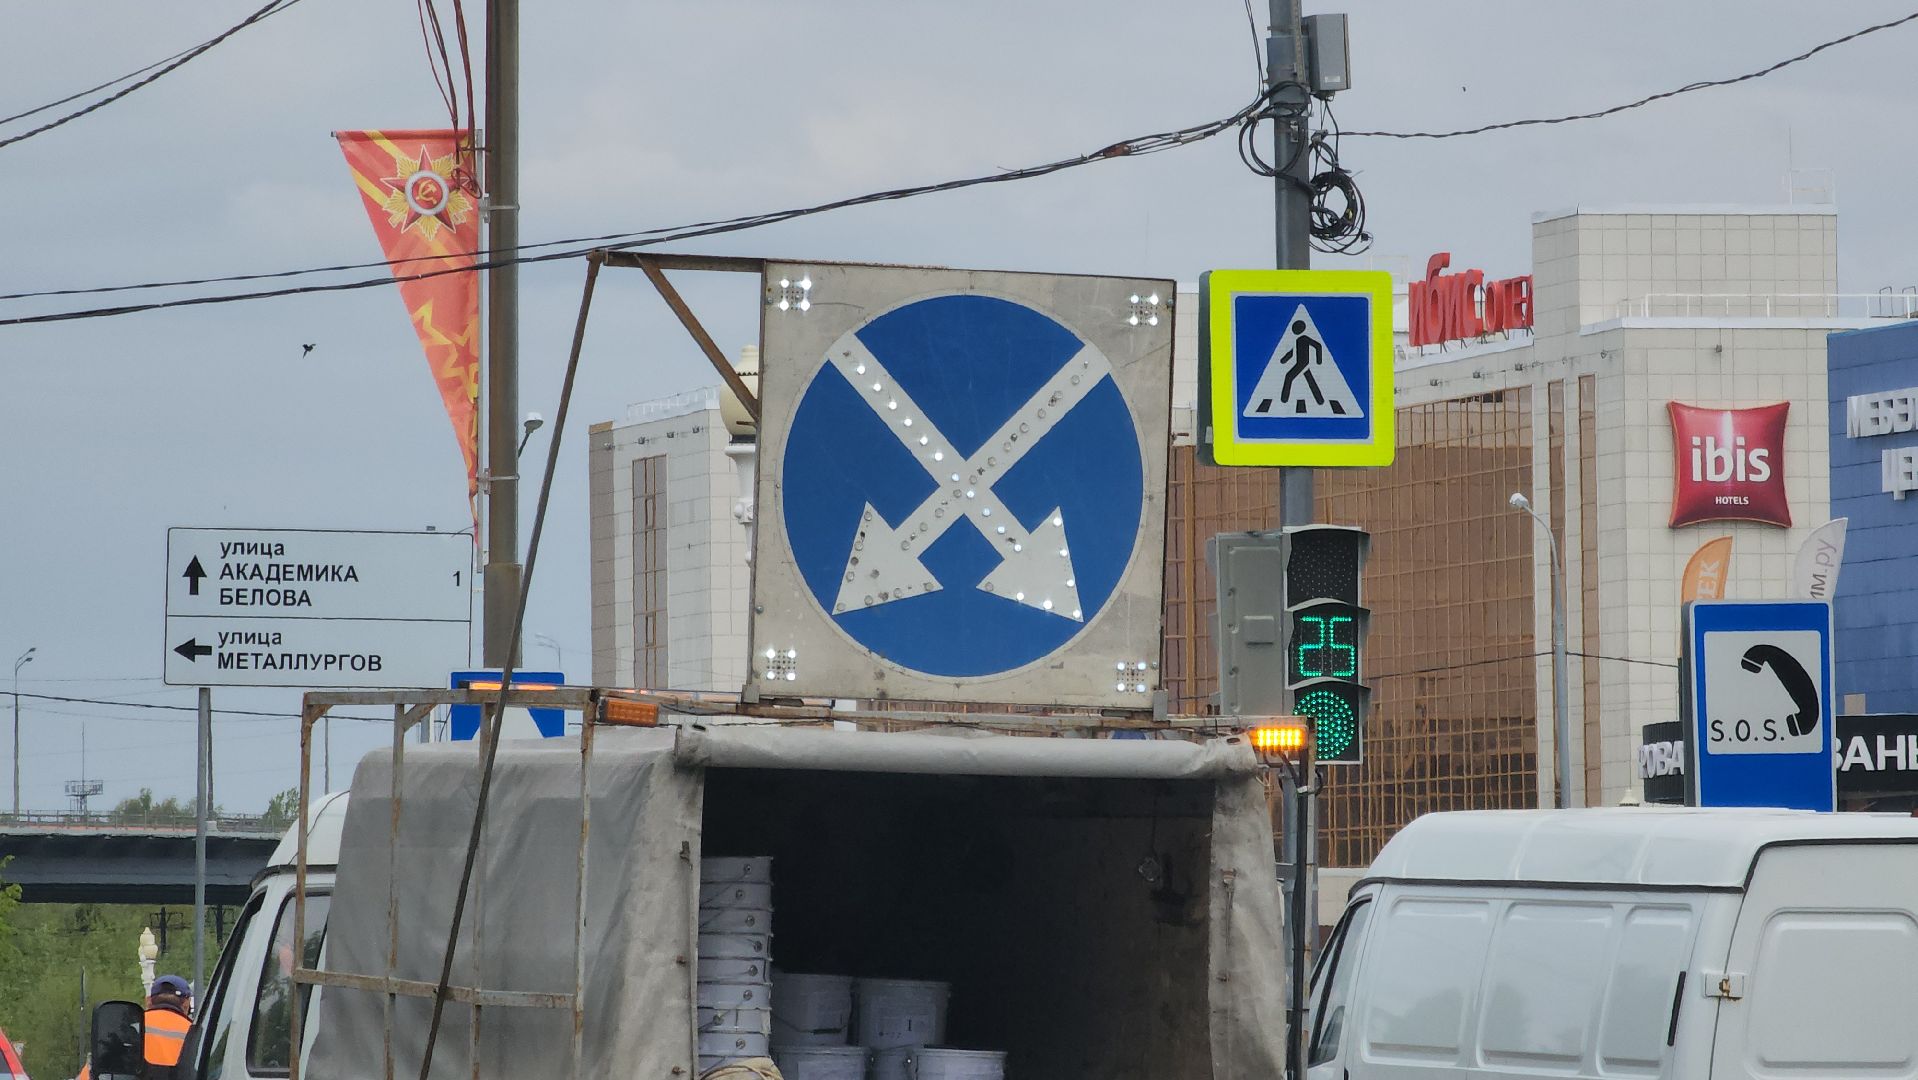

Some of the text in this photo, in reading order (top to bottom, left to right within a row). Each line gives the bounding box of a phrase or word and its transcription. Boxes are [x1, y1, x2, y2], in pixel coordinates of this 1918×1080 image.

[1692, 436, 1771, 482] ibis
[1715, 496, 1749, 505] HOTELS
[219, 541, 285, 559] улица
[219, 562, 461, 587] АКАДЕМИКА 1
[219, 587, 312, 607] БЕЛОВА
[217, 631, 282, 649] улица
[1299, 616, 1355, 677] 25
[217, 652, 382, 672] МЕТАЛЛУРГОВ
[1710, 719, 1785, 742] S.O.S.
